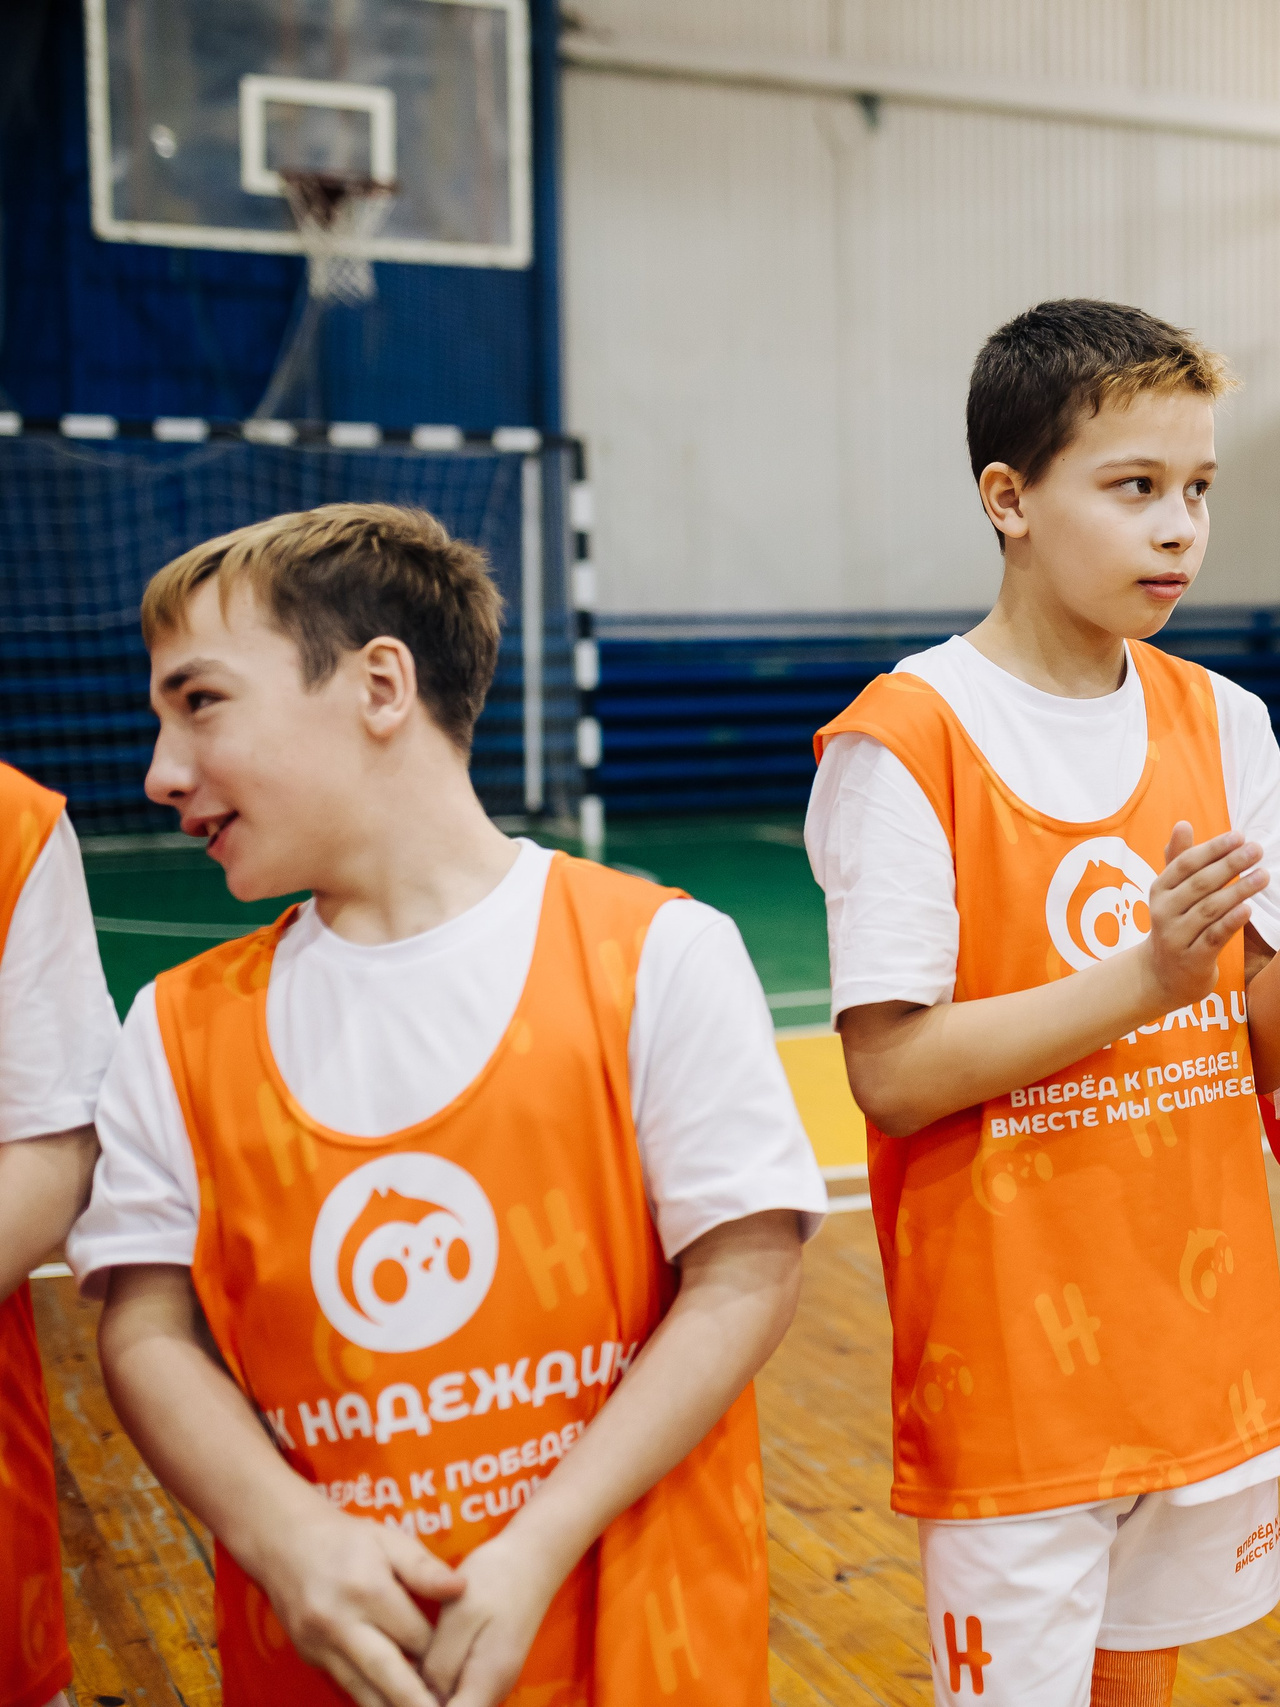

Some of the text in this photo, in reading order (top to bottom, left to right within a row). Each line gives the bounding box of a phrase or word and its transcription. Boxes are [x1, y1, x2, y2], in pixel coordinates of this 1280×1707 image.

[1010, 1050, 1239, 1108] ВПЕРЁД К ПОБЕДЕ!
[990, 1106, 1100, 1139] ВМЕСТЕ
[1105, 1096, 1151, 1124] МЫ
[410, 1469, 436, 1500] К
[1235, 1537, 1274, 1574] ВМЕСТЕ
[1236, 1522, 1274, 1559] ВПЕРЁД
